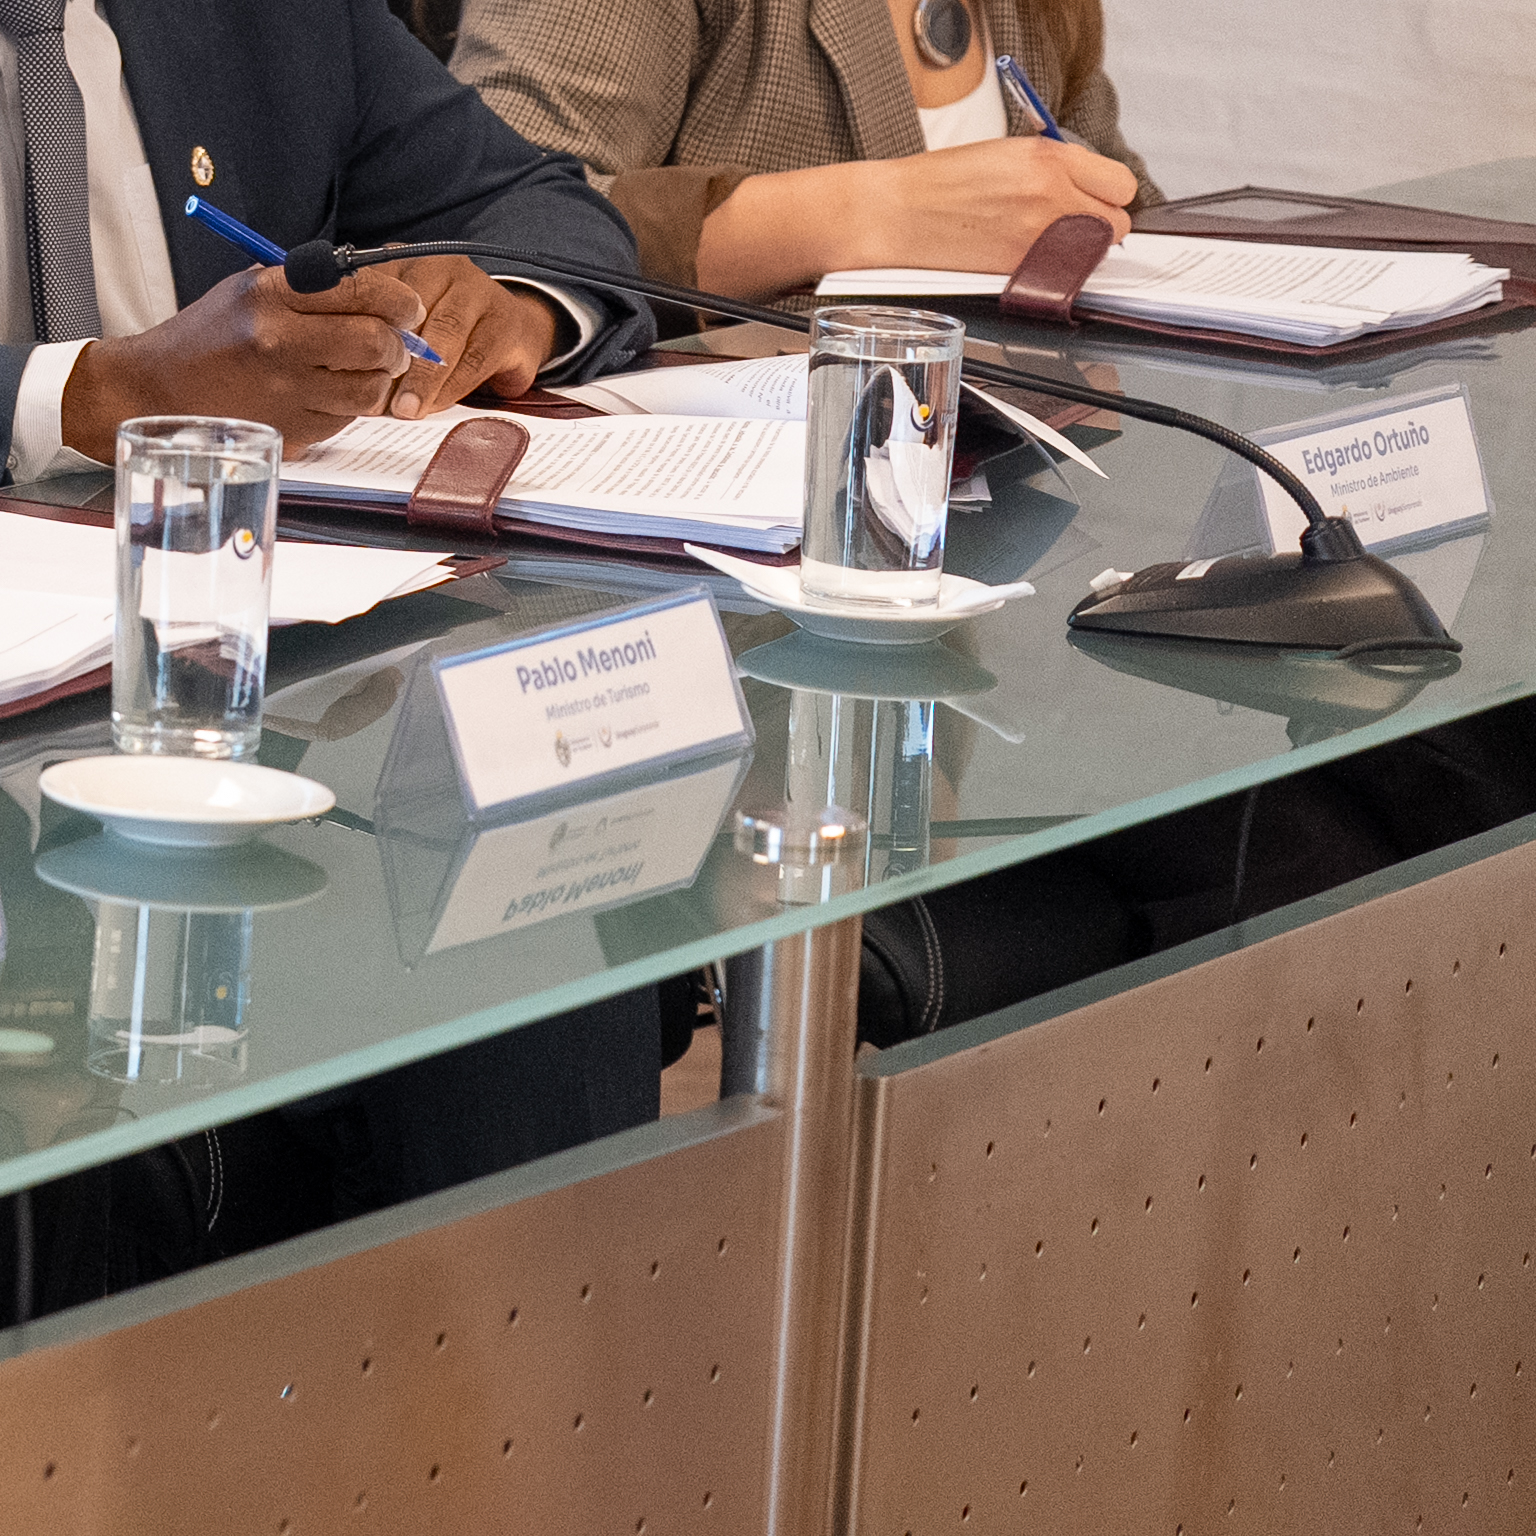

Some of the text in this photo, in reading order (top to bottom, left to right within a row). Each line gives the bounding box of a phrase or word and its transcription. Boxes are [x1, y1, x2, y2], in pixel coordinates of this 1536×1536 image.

[1302, 421, 1430, 476] Edgardo Ortuño
[1330, 465, 1420, 498] Ministro de Ambiente
[516, 630, 657, 694] Pablo Menoni
[545, 682, 650, 722] Ministro de Turismo
